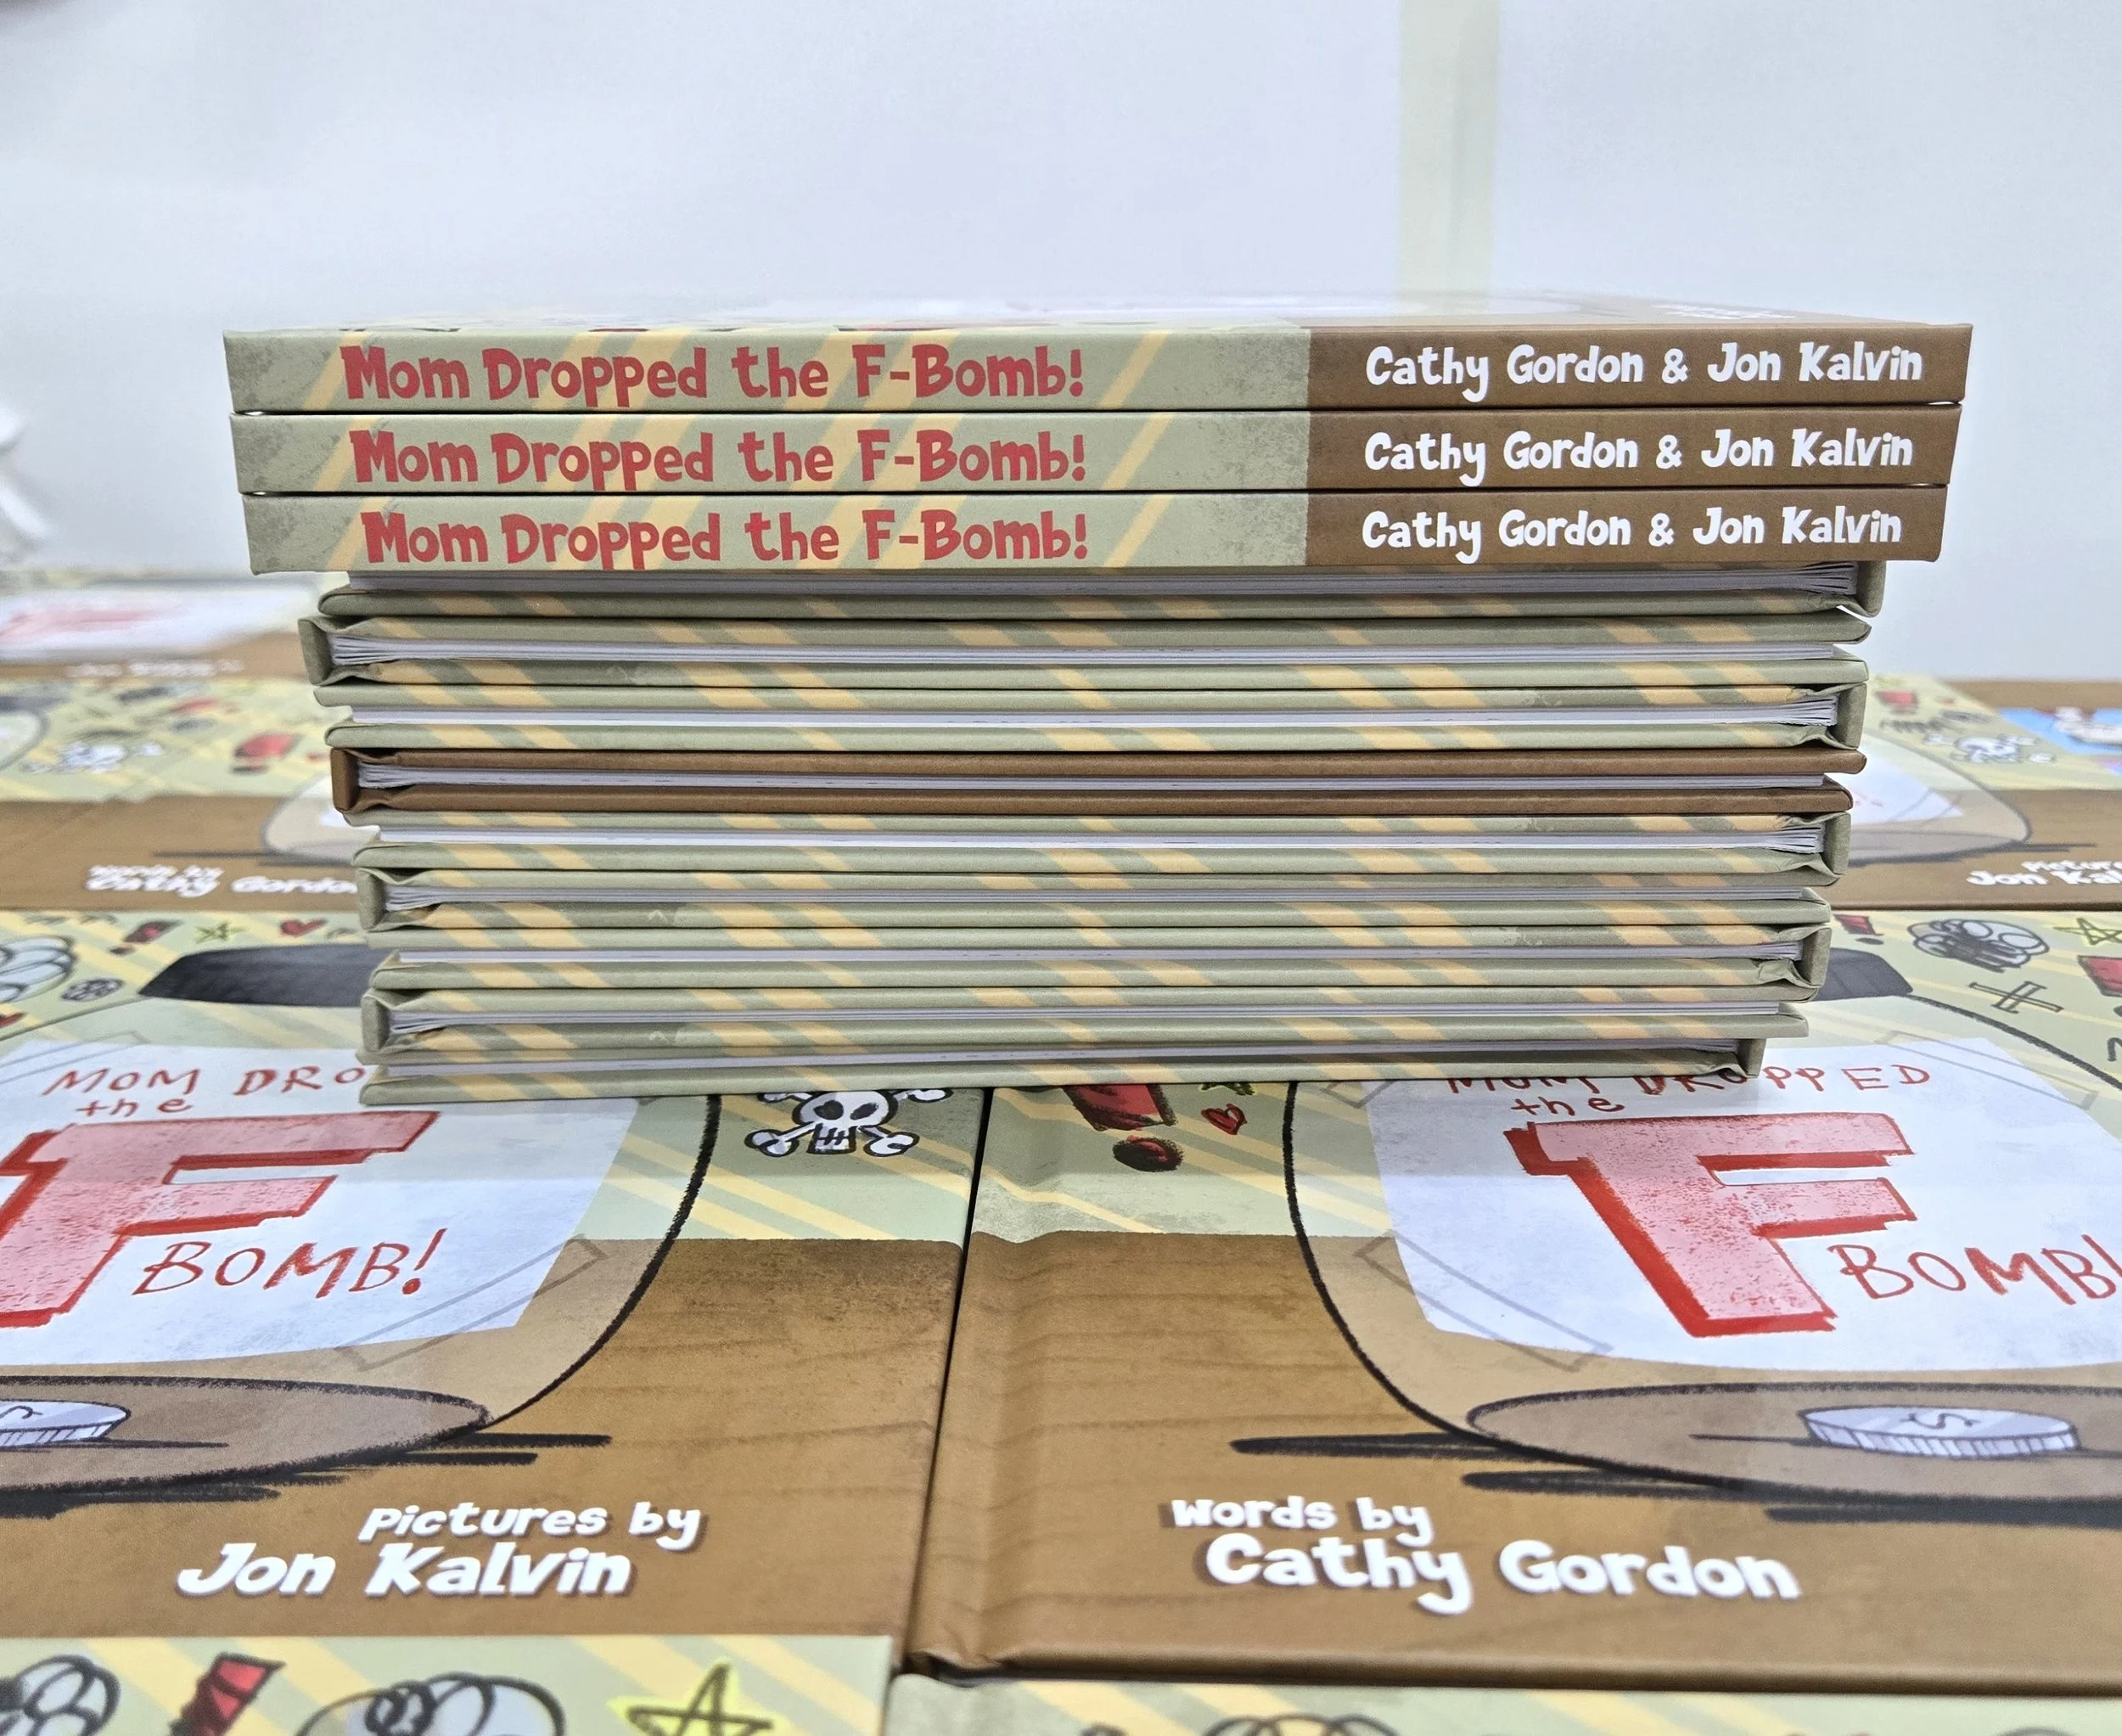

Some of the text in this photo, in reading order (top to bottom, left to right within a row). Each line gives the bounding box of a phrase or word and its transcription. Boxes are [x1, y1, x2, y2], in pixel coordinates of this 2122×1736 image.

[342, 344, 1083, 407] Mom Dropped the F-Bomb!
[1366, 340, 1923, 402] Cathy Gordon & Jon Kalvin
[350, 430, 1085, 491] Mom Dropped the F-Bomb!
[1365, 427, 1913, 487] Cathy Gordon & Jon Kalvin
[362, 509, 1087, 570] Mom Dropped the F-Bomb!
[1362, 505, 1902, 565] Cathy Gordon & Jon Kalvin
[1966, 870, 2122, 885] Jon Kal
[39, 1068, 201, 1097] MOM
[76, 1098, 195, 1118] the
[1511, 1096, 1625, 1116] the
[0, 1110, 441, 1329] F
[1503, 1112, 1917, 1339] F
[132, 1228, 448, 1299] BOMB!
[628, 1501, 702, 1551] by
[1356, 1497, 1435, 1548] by
[177, 1542, 632, 1596] Jon Kalvin
[1205, 1532, 1803, 1615] Cathy Gordon
